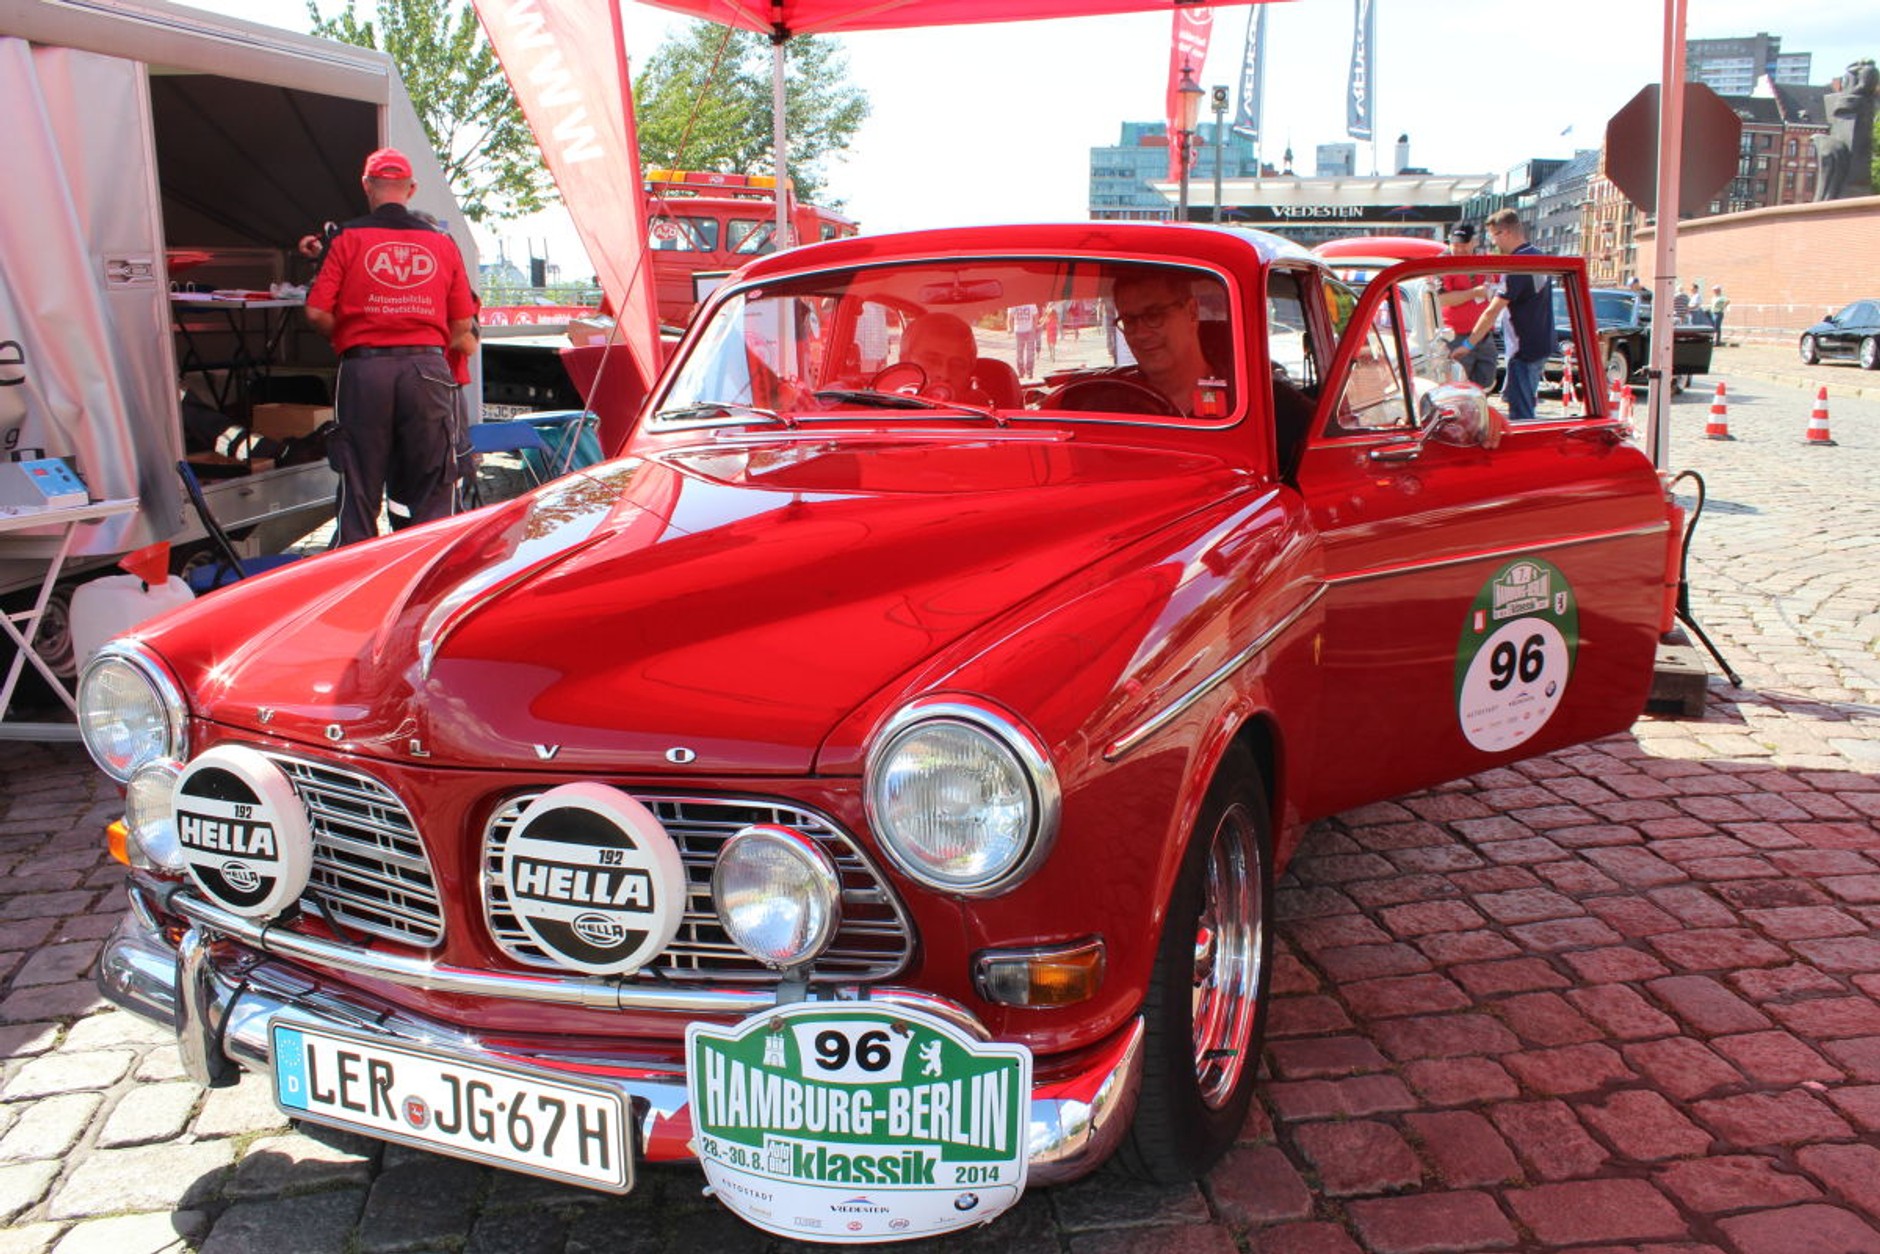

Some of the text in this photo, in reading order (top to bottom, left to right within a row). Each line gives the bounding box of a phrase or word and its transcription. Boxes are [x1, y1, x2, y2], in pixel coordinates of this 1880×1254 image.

[1269, 205, 1364, 218] VREDESTEIN
[368, 294, 432, 305] Automobilclub
[382, 305, 436, 316] Deutschland
[1489, 633, 1545, 691] 96
[234, 804, 253, 819] 192
[181, 815, 274, 856] HELLA
[598, 849, 624, 866] 192
[224, 869, 259, 884] HELLA
[516, 862, 650, 908] HELLA
[577, 923, 624, 939] HELLA
[814, 1029, 892, 1072] 96
[287, 1074, 300, 1093] D
[307, 1043, 398, 1122] LER
[704, 1046, 1010, 1152] HAMBURG-BERLIN
[792, 1145, 938, 1185] klassik
[955, 1165, 1001, 1184] 2014
